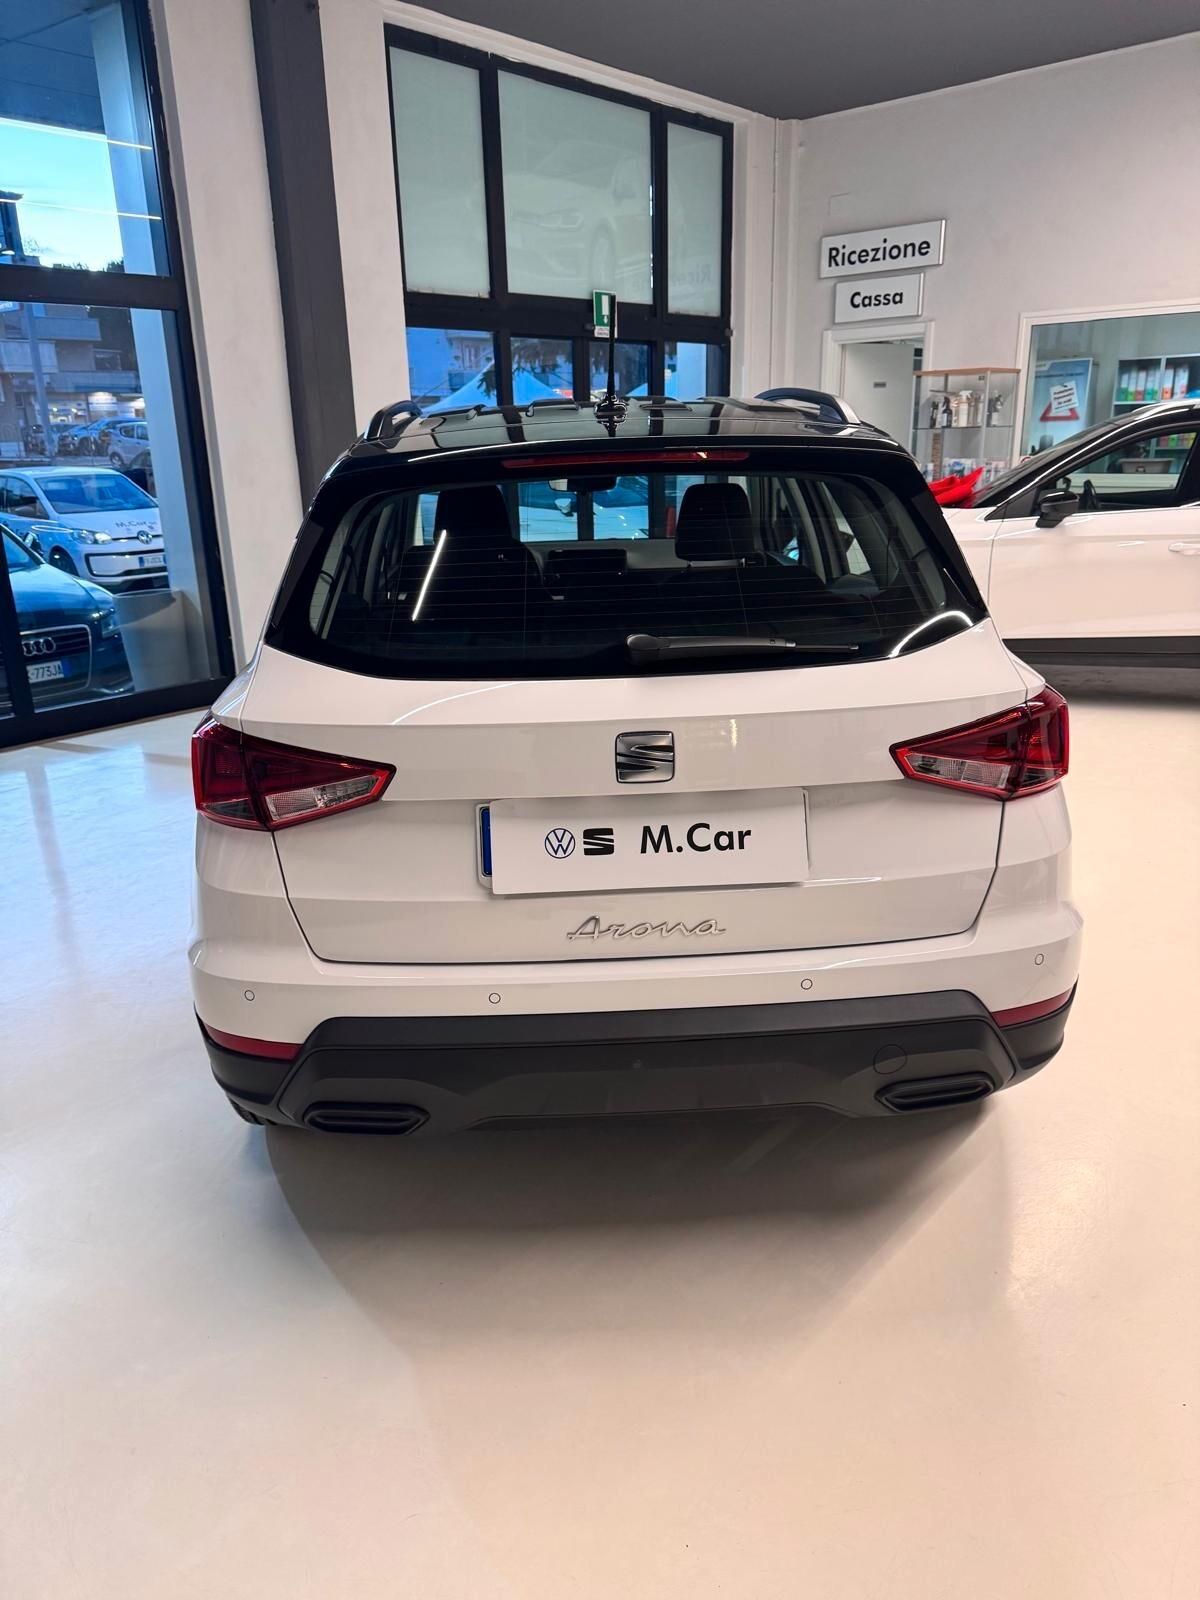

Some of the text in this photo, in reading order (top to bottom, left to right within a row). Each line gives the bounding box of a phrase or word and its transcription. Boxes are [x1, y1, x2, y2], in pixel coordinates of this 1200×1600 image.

[828, 238, 931, 267] Ricezione
[850, 291, 904, 309] Cassa
[640, 822, 752, 854] M.Car
[567, 915, 727, 941] Arona
